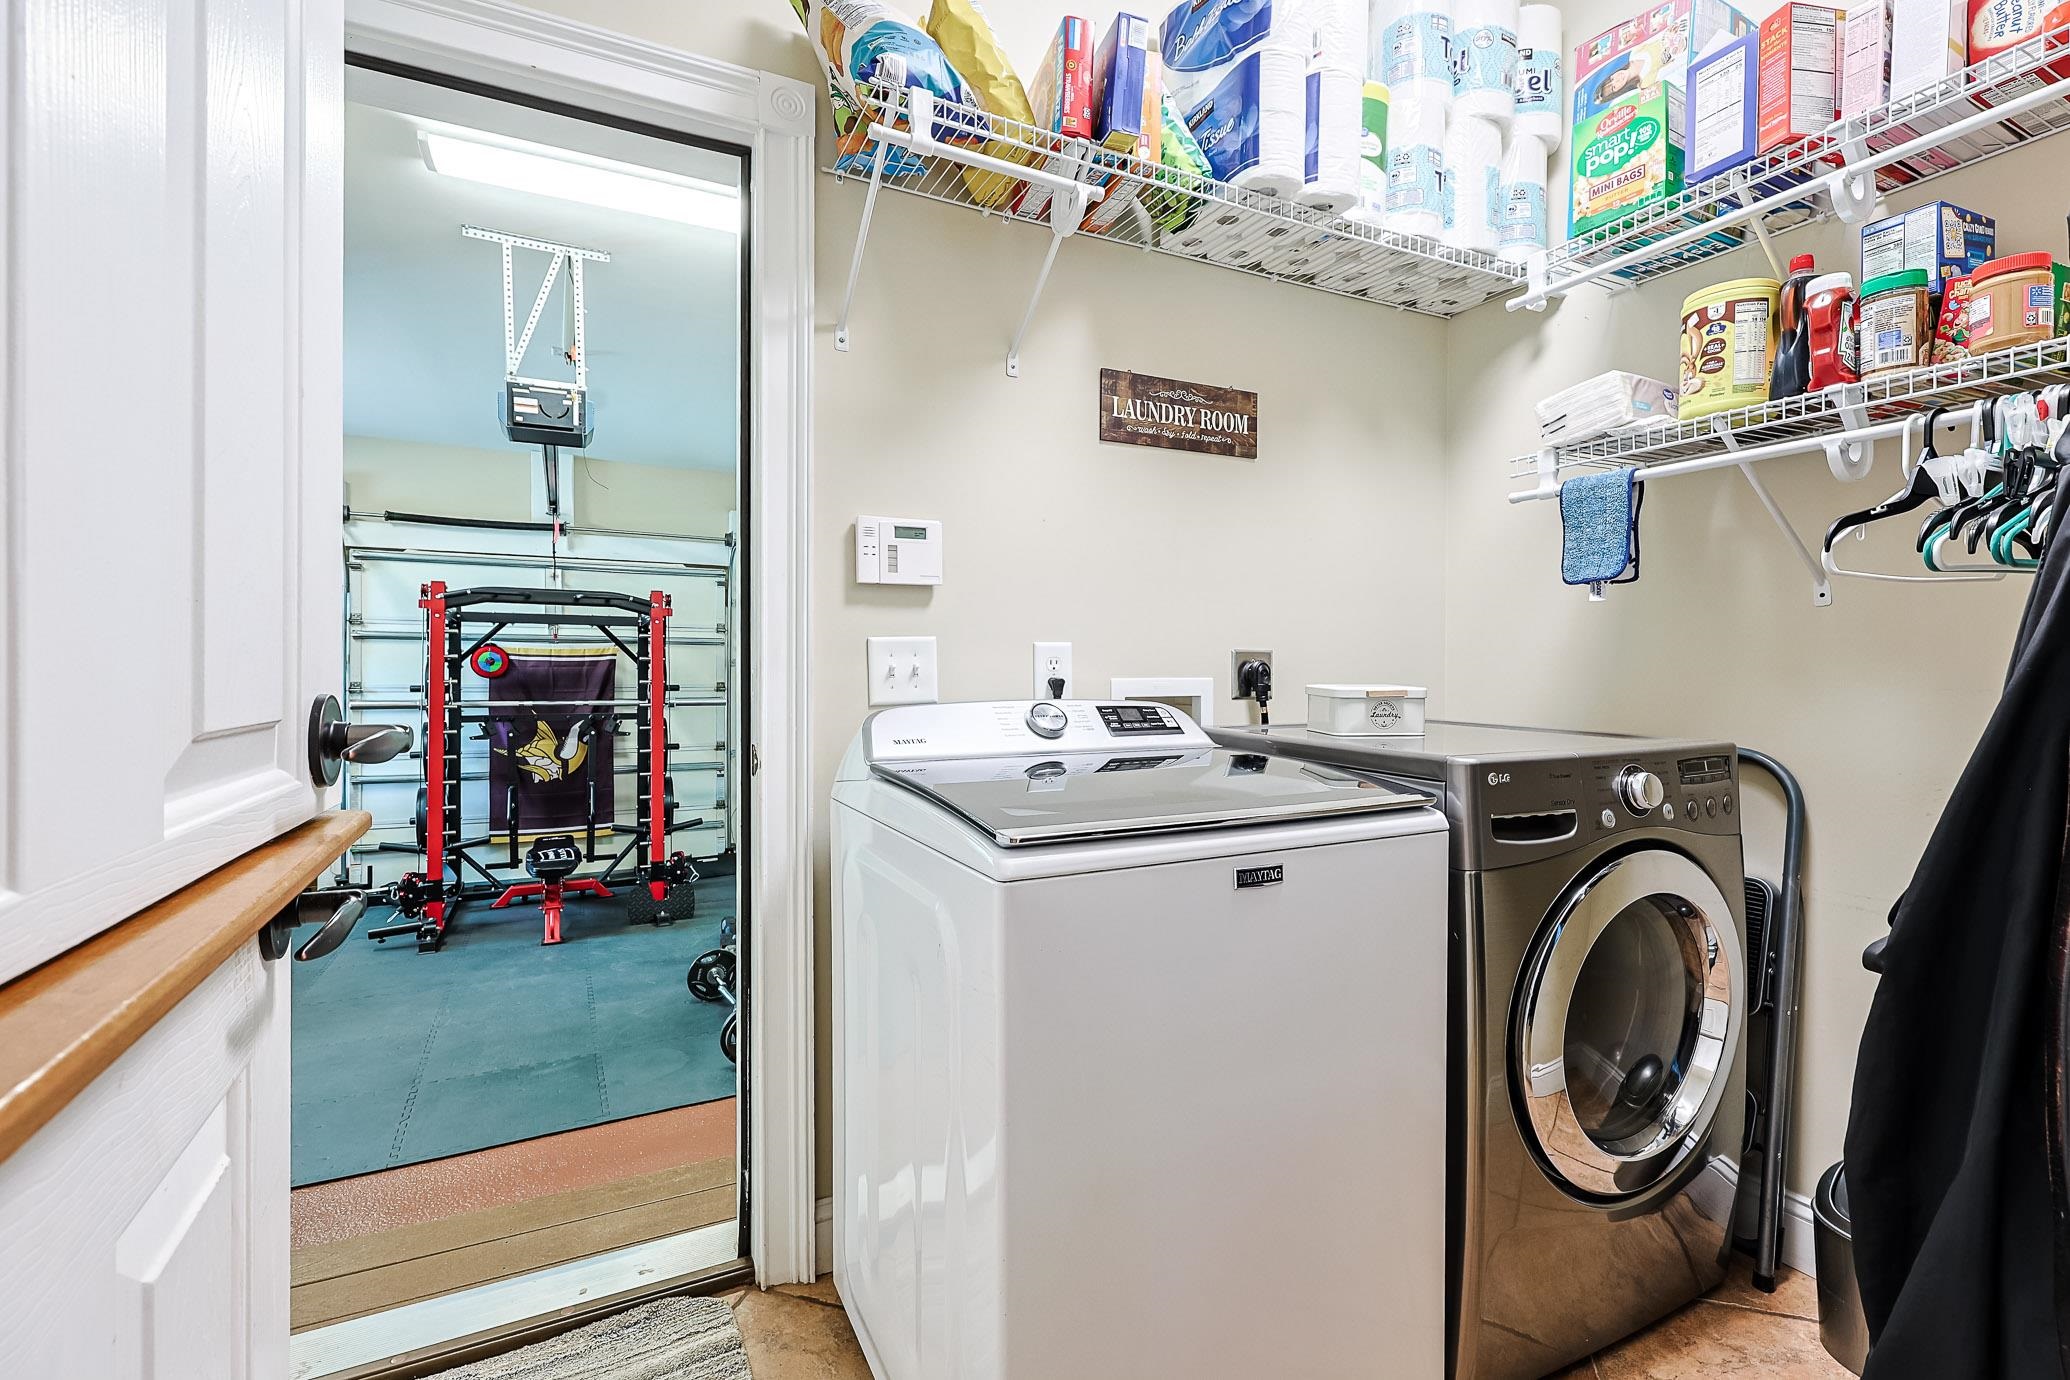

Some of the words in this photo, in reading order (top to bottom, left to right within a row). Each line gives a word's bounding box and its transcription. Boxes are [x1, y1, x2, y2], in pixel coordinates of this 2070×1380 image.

[1760, 26, 1788, 49] STACK
[1187, 100, 1214, 129] KIRKLAND
[1201, 117, 1235, 151] Tissue
[1585, 128, 1630, 160] smart
[1585, 131, 1638, 178] pop!
[1592, 181, 1615, 196] MINI
[1616, 168, 1643, 186] BAGS
[1112, 396, 1197, 428] LAUNDRY
[1200, 409, 1249, 435] ROOM
[1138, 426, 1158, 434] wash
[1161, 427, 1175, 439] dry
[1181, 431, 1197, 440] fold
[1200, 434, 1221, 443] repeat
[1238, 868, 1282, 884] MAYTAG
